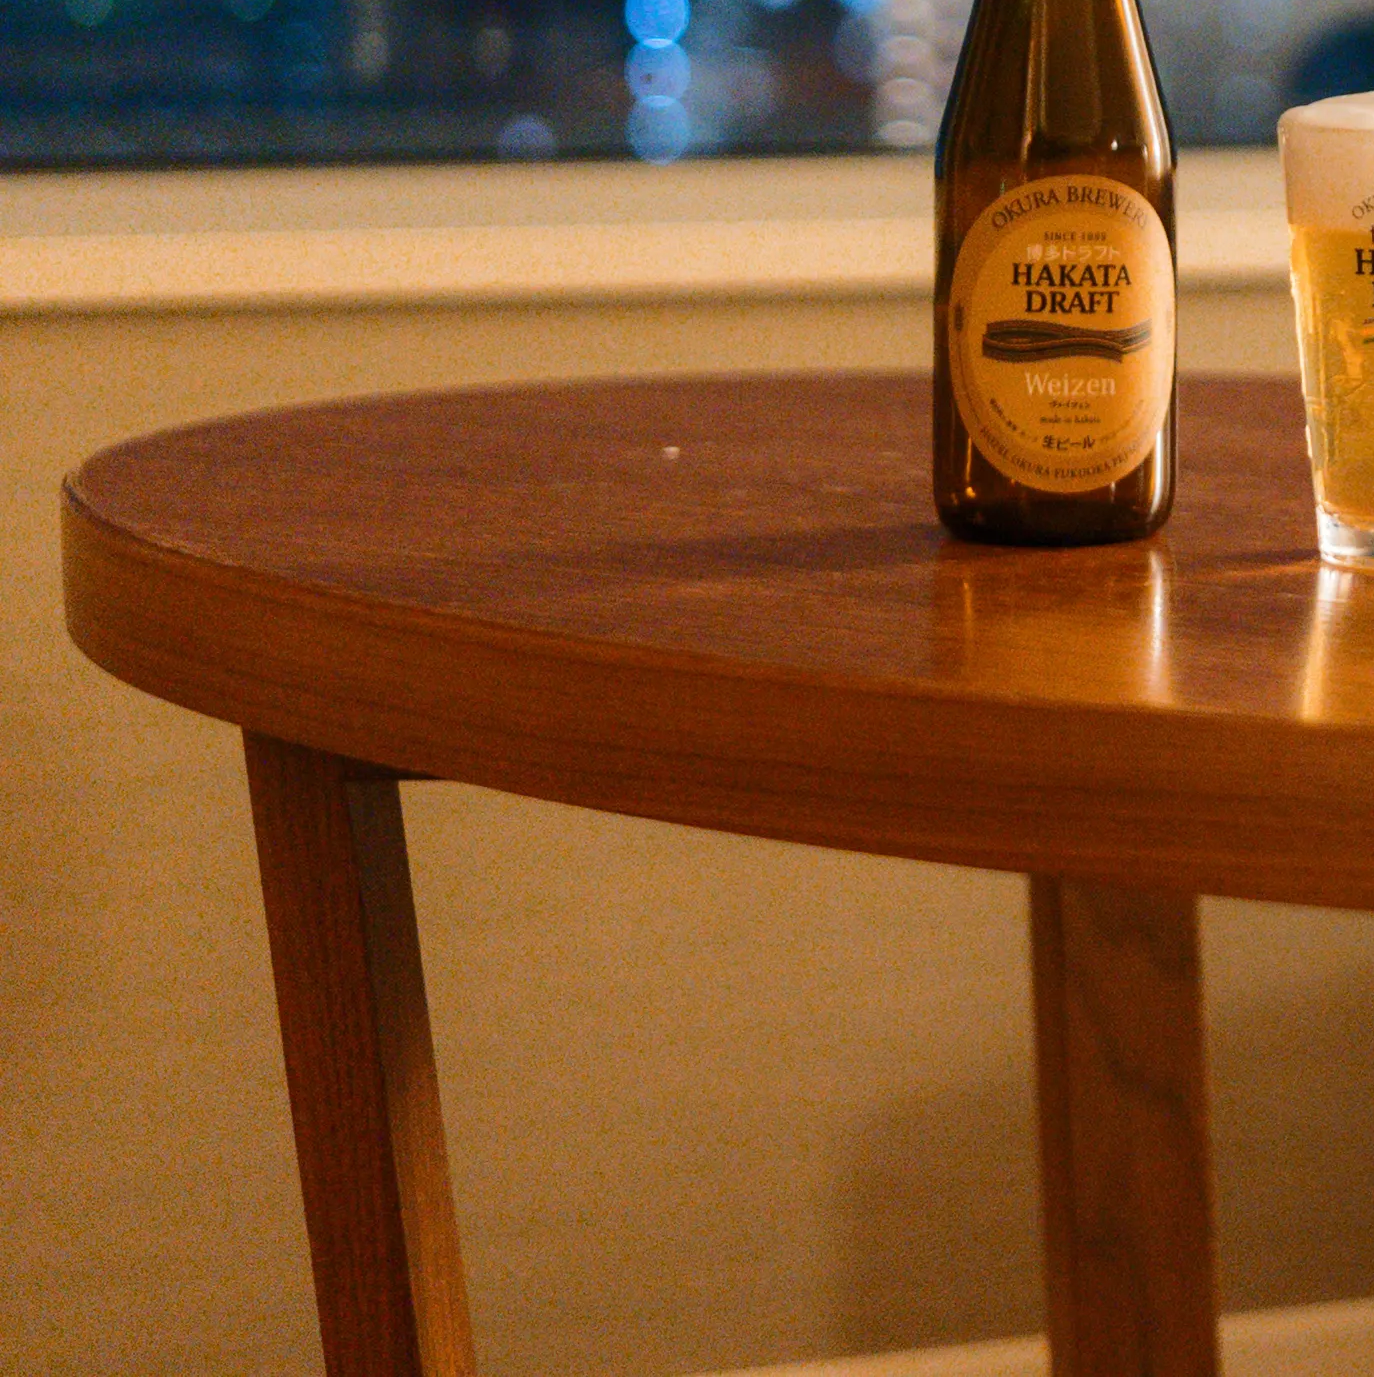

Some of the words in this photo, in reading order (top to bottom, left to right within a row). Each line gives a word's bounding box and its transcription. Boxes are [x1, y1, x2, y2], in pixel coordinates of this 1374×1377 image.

[991, 189, 1060, 229] OKURA
[1011, 263, 1132, 288] HAKATA
[1024, 290, 1120, 314] DRAFT
[1025, 372, 1116, 396] Weizen
[1042, 434, 1096, 451] 生ビール
